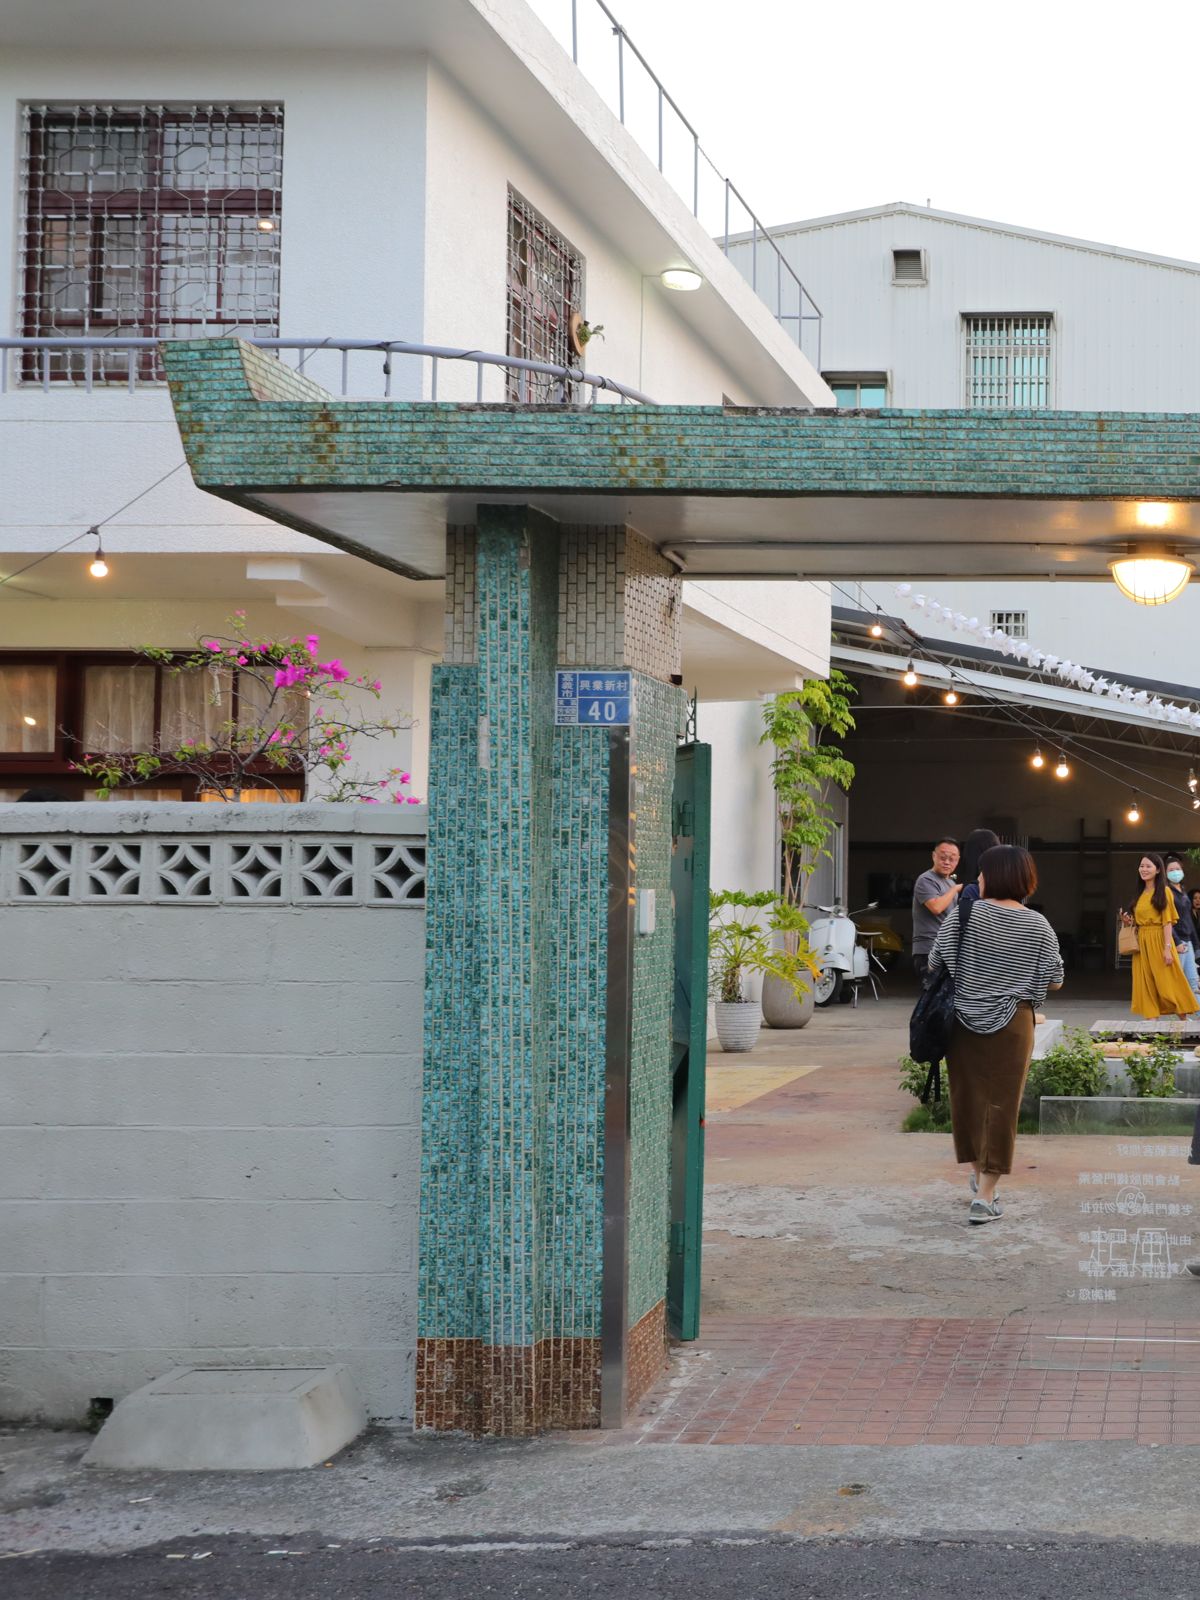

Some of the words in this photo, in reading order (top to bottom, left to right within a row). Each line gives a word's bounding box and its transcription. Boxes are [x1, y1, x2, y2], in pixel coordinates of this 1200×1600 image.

[579, 680, 628, 691] 興業新村
[588, 701, 616, 721] 40
